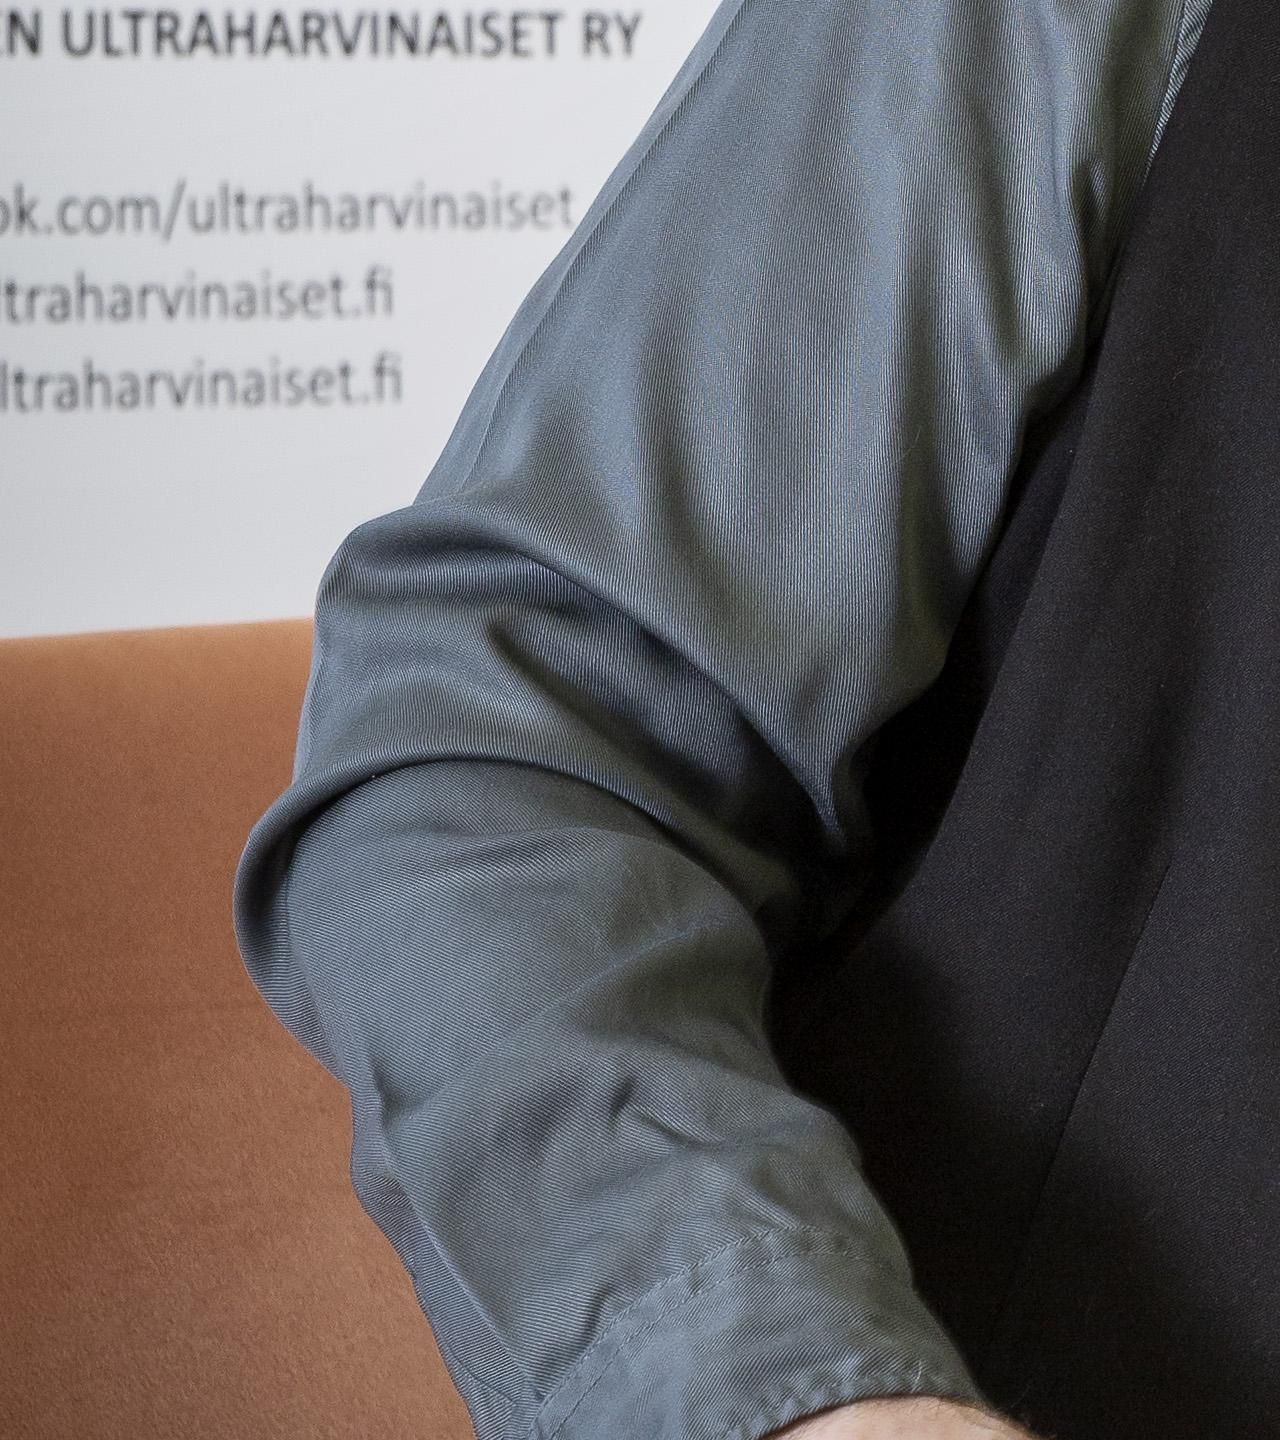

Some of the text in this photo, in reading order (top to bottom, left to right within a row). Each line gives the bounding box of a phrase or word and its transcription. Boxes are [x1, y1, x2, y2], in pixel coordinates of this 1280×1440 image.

[60, 7, 566, 59] ULTRAHARVINAISET
[579, 9, 644, 58] RY
[0, 265, 396, 324] traharvinaiset.fi
[0, 351, 404, 414] ltraharvinaiset.fi
